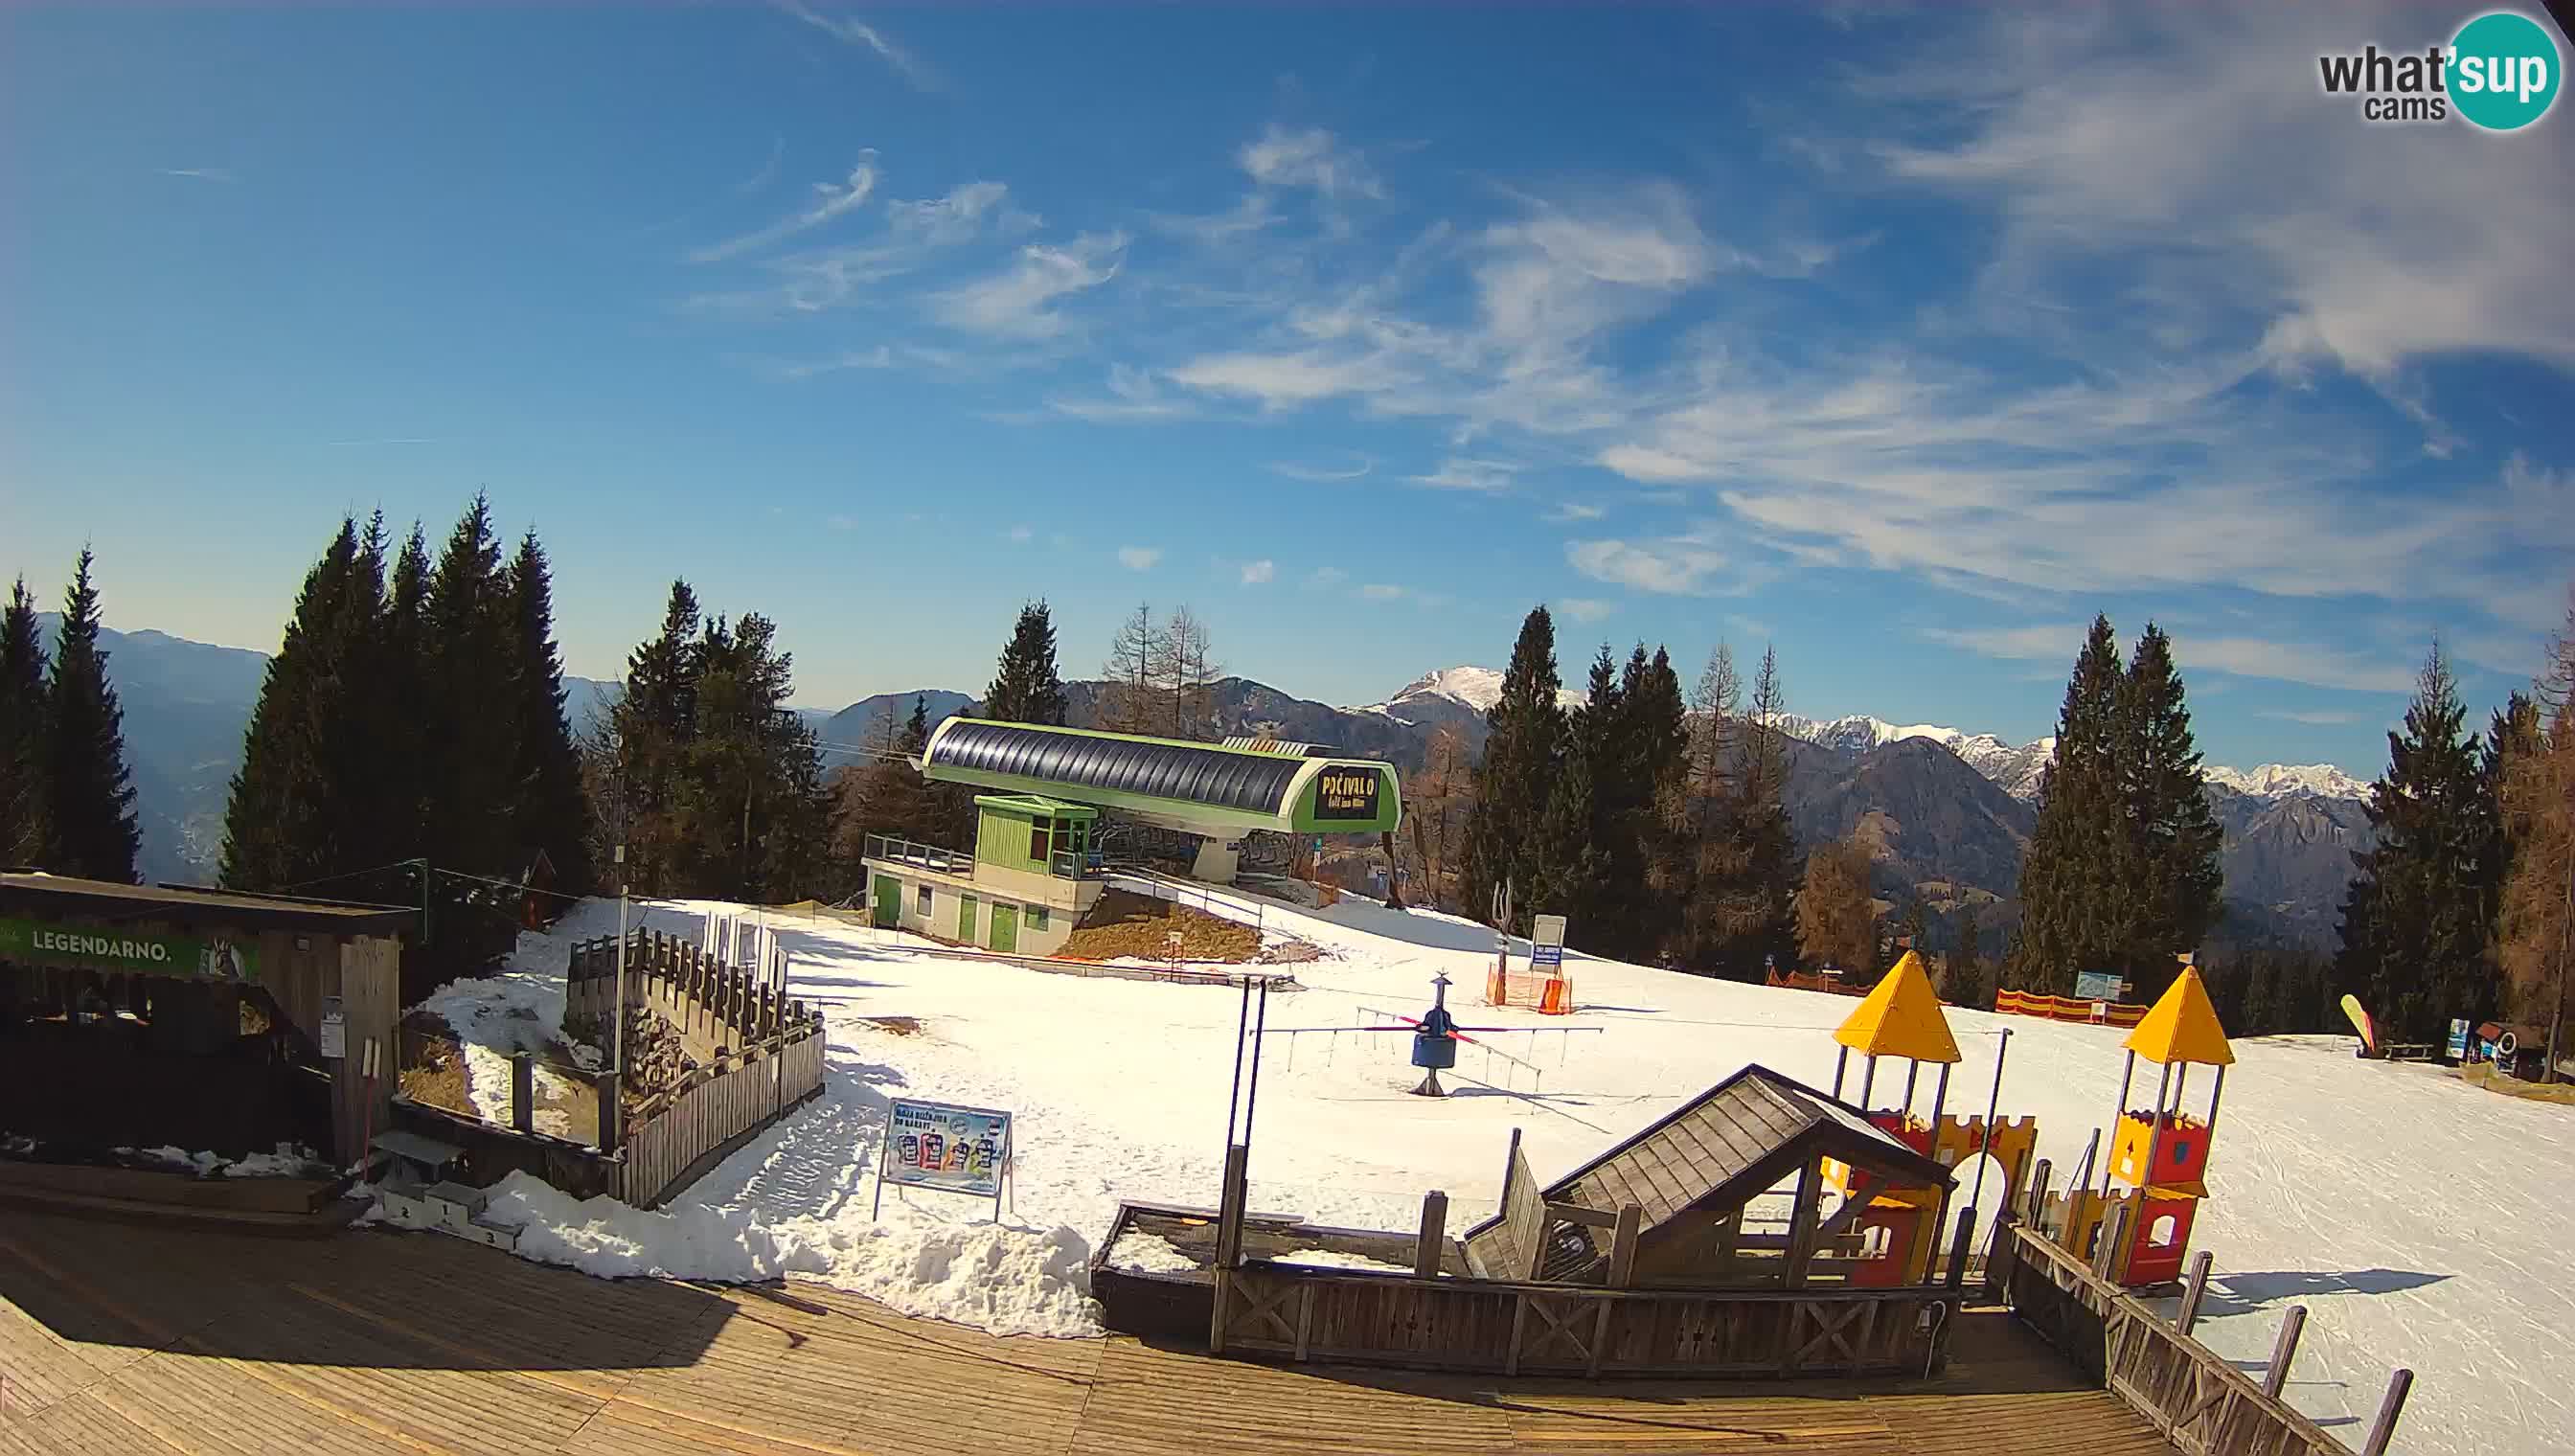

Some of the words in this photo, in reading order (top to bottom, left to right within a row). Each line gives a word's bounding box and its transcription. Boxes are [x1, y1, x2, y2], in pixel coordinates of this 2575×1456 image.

[33, 930, 172, 962] LEGENDARNO.
[400, 1206, 411, 1218] 2
[486, 1232, 496, 1243] 3
